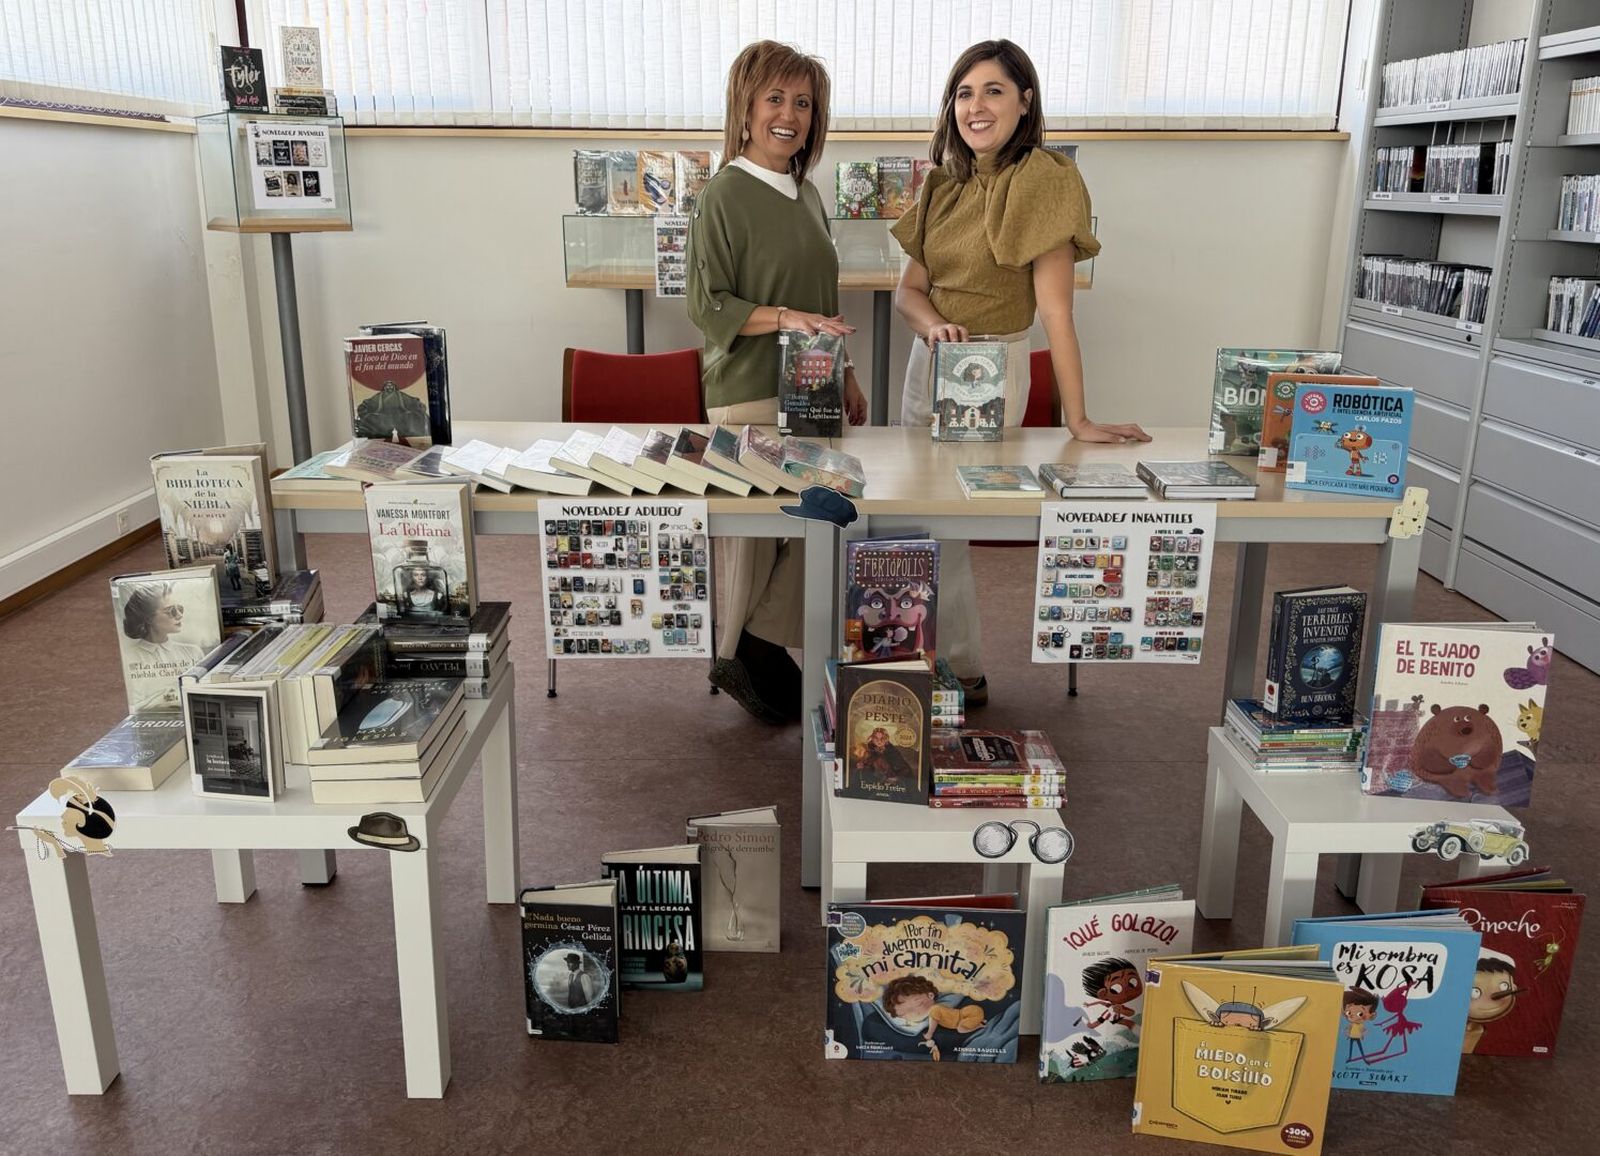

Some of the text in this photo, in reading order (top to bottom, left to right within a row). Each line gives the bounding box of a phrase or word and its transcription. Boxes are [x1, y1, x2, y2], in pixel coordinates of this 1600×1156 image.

[225, 64, 260, 94] Tyler
[354, 343, 402, 352] JAVIER CERCAS
[362, 363, 374, 373] fin
[1333, 393, 1404, 412] ROBÓTICA
[166, 479, 243, 488] BIBLIOTECA
[184, 500, 231, 509] NIEBLA
[562, 505, 683, 516] NOVEDADES ADULTOS
[376, 510, 450, 520] VANESSA MONTFORT
[1057, 512, 1193, 524] NOVEDADES INFANTILES
[379, 522, 451, 537] La Toffana
[1302, 613, 1353, 626] TERRIBLES
[1302, 625, 1350, 638] INVENTOS
[1396, 640, 1480, 660] EL TEJADO
[420, 662, 460, 671] PELAYO
[1397, 658, 1475, 678] DE BENITO
[131, 670, 156, 679] niebla
[863, 694, 912, 705] DIARIO
[865, 712, 907, 724] PESTE
[696, 828, 775, 842] Pedro Simón
[636, 865, 693, 904] ÚLTIMA
[532, 913, 554, 922] Nada
[1459, 908, 1540, 938] Pinocho
[524, 920, 610, 932] germina César Pérez
[904, 923, 942, 938] ¡Por fin
[1063, 914, 1103, 950] ¡QUÉ
[582, 932, 612, 941] Gellida
[882, 937, 944, 956] duermo en
[1338, 943, 1438, 964] Mi sombra
[862, 949, 986, 981] mi camita!
[1336, 960, 1435, 993] es ROSA
[1196, 1048, 1246, 1064] MIEDO
